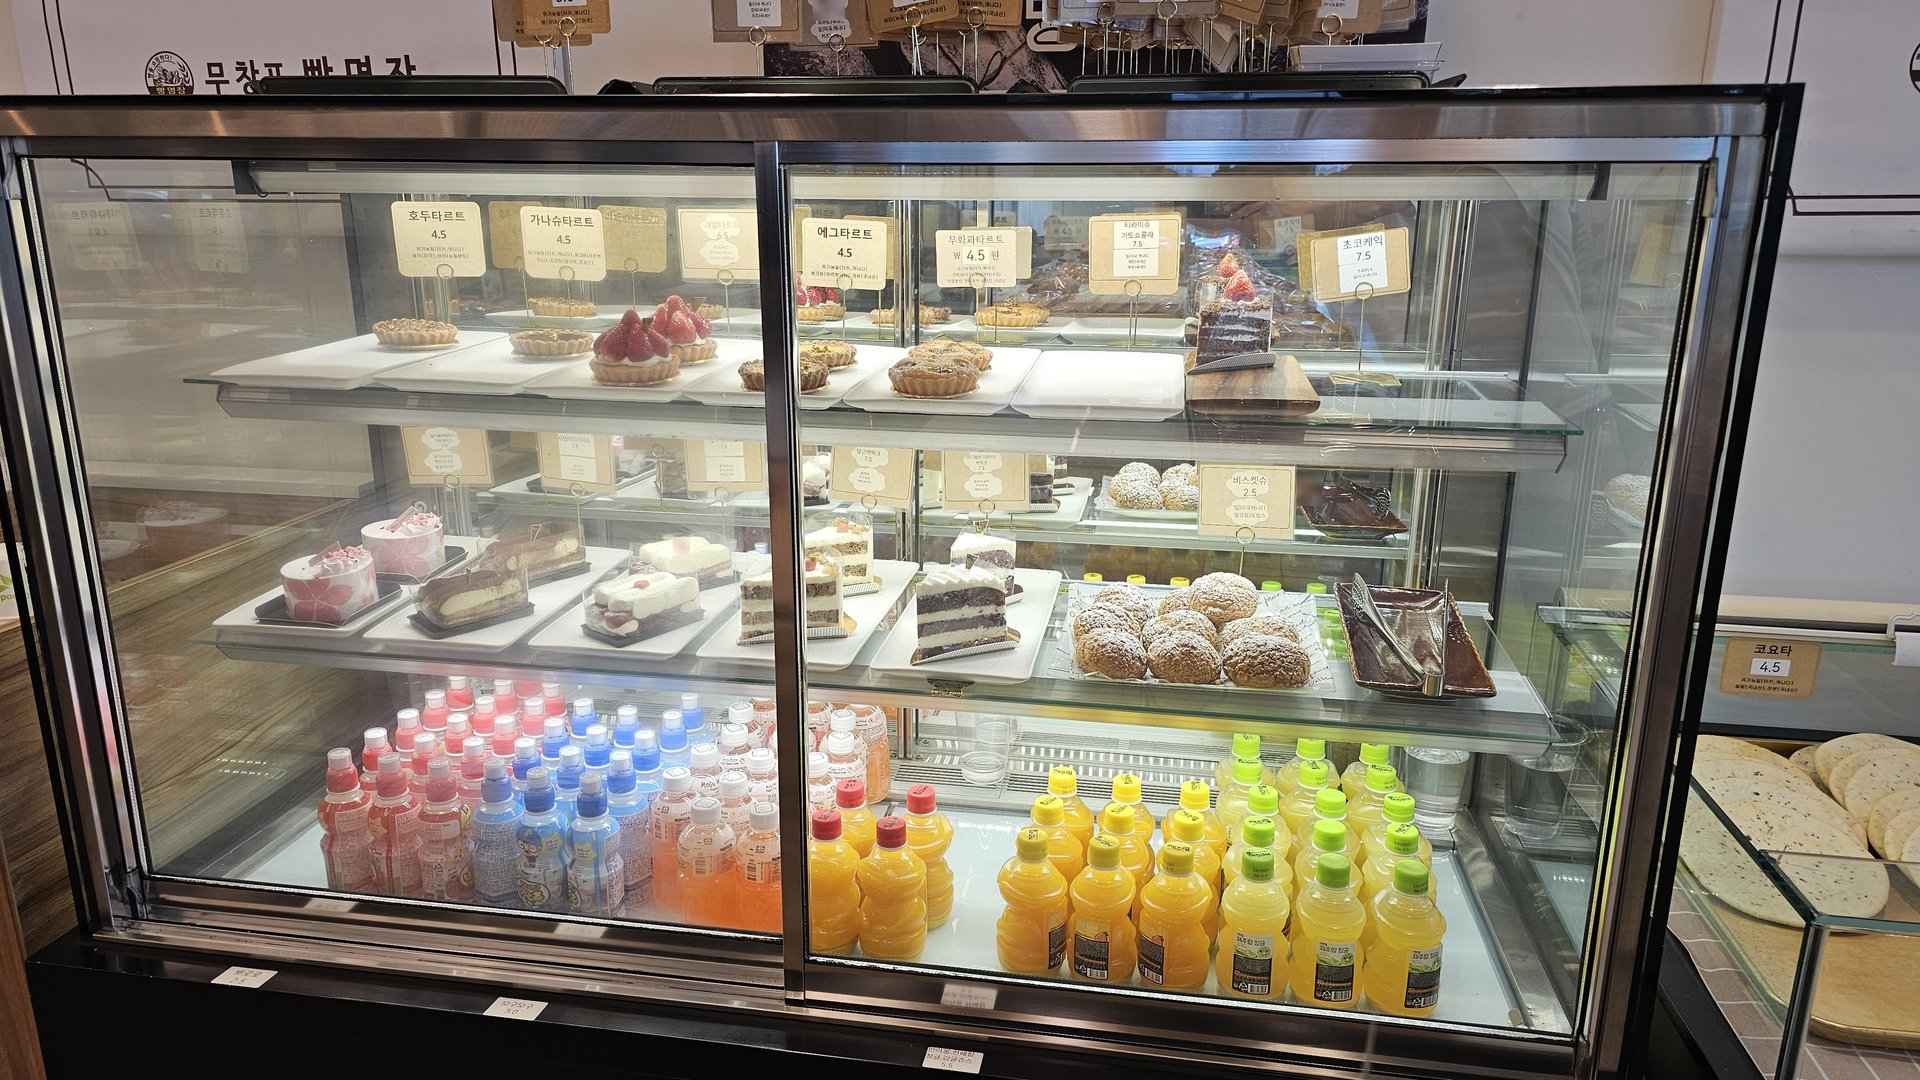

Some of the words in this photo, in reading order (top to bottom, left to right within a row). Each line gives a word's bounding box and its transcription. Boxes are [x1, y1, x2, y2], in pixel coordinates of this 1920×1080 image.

[408, 210, 466, 222] 호두타르트
[530, 214, 594, 228] 가나슈타르트
[1124, 221, 1151, 229] 티라미슈
[431, 230, 447, 240] 4.5
[716, 231, 729, 240] 6.5
[817, 226, 873, 240] 에그타르트
[556, 234, 571, 245] 4.5
[947, 234, 1005, 245] 무화과타르트
[1132, 240, 1143, 248] 7.5
[1342, 234, 1384, 250] 초코케익
[837, 247, 853, 258] 4.5
[966, 249, 985, 261] 4.5
[990, 250, 1000, 260] 원
[1356, 250, 1372, 261] 7.5
[1243, 488, 1257, 497] 2.5
[1754, 644, 1793, 657] 코요타
[1760, 661, 1781, 673] 4.5
